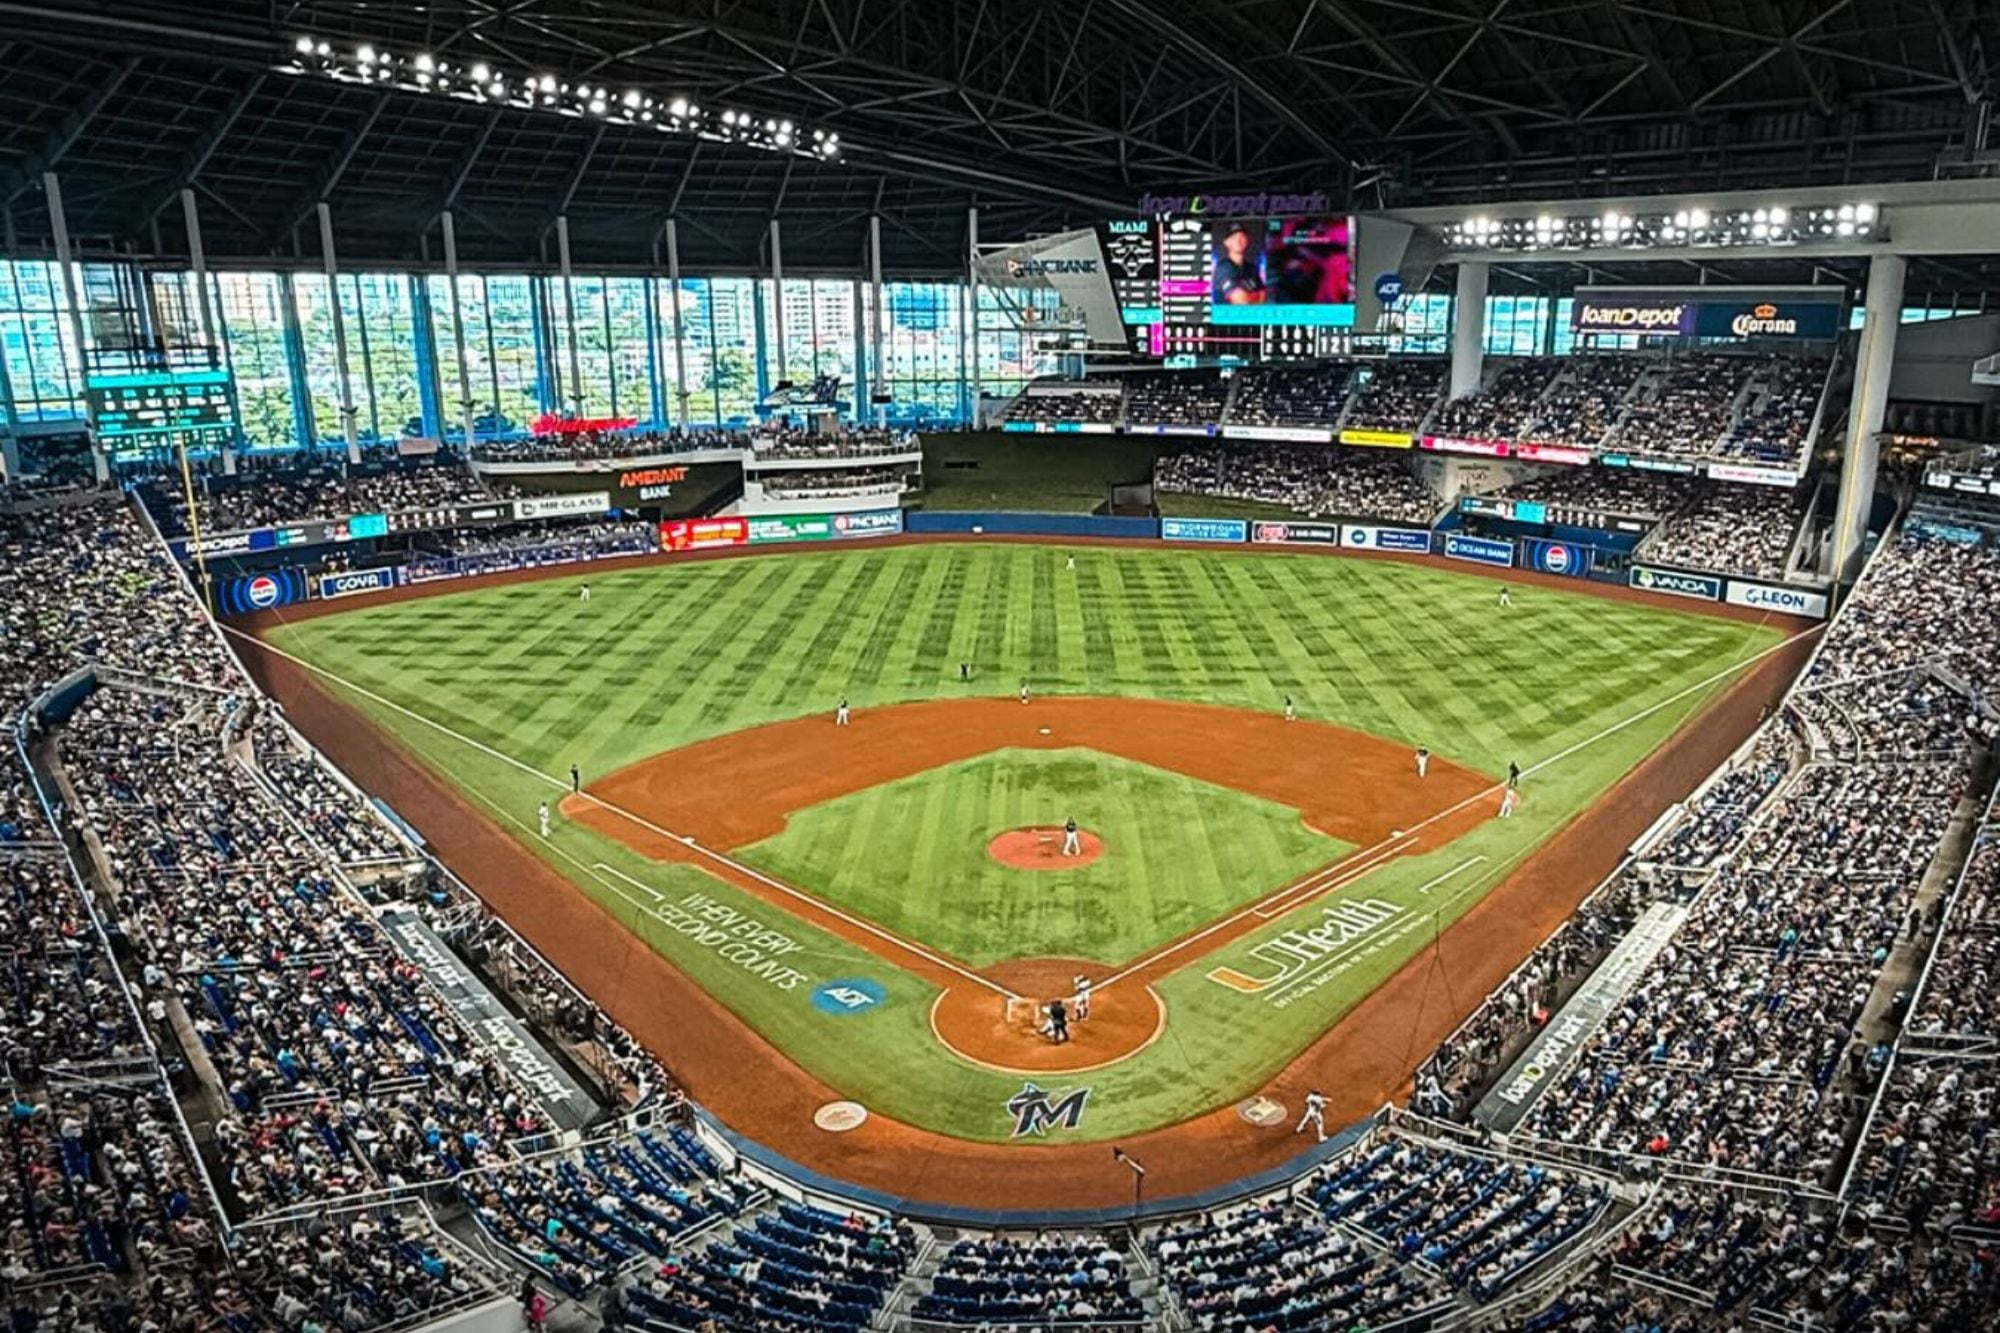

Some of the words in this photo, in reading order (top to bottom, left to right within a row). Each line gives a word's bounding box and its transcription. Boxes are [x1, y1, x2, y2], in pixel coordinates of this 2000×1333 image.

[1108, 221, 1148, 234] MIAMI
[1378, 283, 1401, 294] ADT
[1580, 304, 1684, 329] loanDepot
[1732, 315, 1797, 335] Corona
[1331, 336, 1341, 354] 2
[619, 467, 690, 488] AMERANT
[562, 497, 603, 508] GLASS
[639, 487, 672, 501] BANK
[185, 534, 250, 553] loanDepot
[1459, 544, 1486, 555] OCEAN
[1487, 547, 1509, 559] BANK
[335, 573, 379, 591] GOYA
[1655, 574, 1708, 593] VANDA
[1760, 592, 1806, 608] LEON
[680, 892, 743, 931] WHEN
[735, 919, 806, 956] EVERY
[657, 903, 730, 946] SECOND
[719, 941, 809, 991] COUNTS
[822, 986, 876, 1009] ADT
[1498, 1037, 1567, 1106] loanDepot
